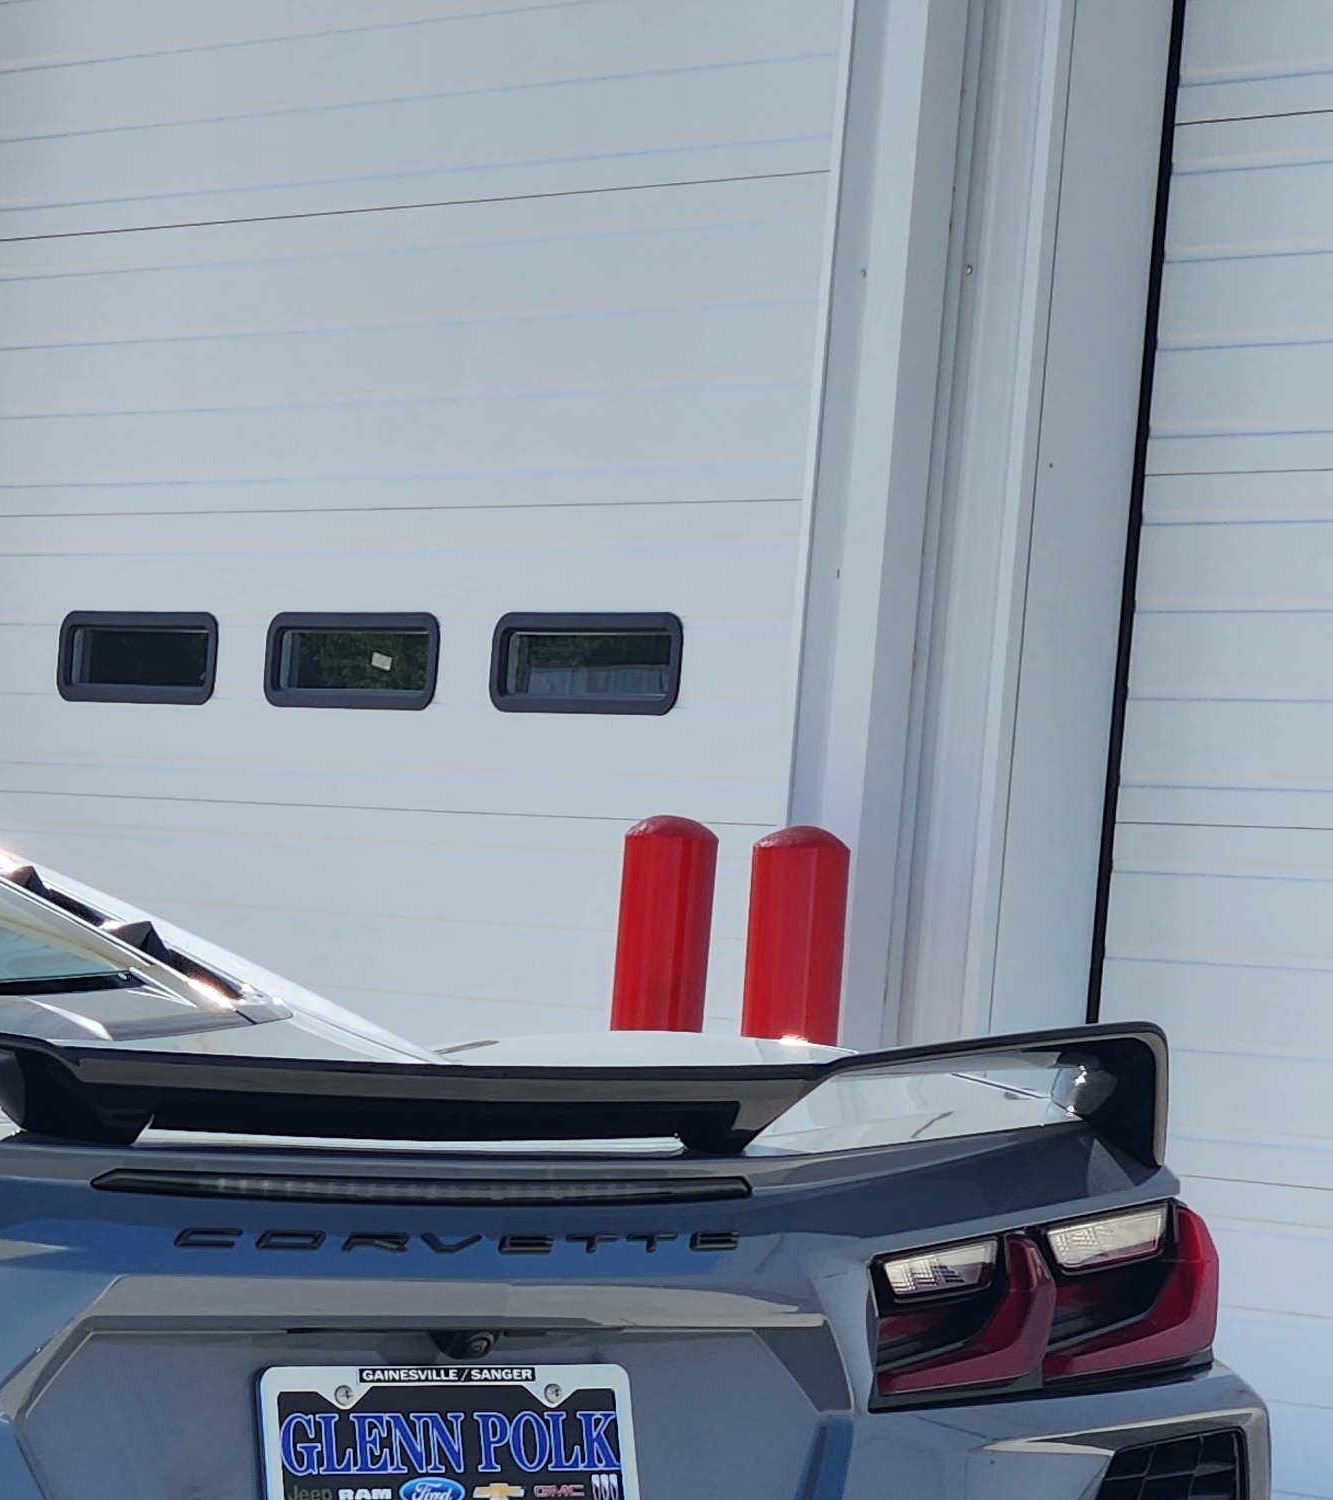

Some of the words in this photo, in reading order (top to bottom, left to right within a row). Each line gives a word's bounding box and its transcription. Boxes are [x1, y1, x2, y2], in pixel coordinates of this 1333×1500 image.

[173, 1227, 740, 1255] CORVETTE
[362, 1369, 459, 1381] GAINESVILLE
[471, 1368, 533, 1380] SANGER
[280, 1412, 464, 1476] GLENN
[473, 1411, 621, 1473] POLK
[338, 1488, 392, 1500] RAM
[533, 1484, 585, 1498] GMC
